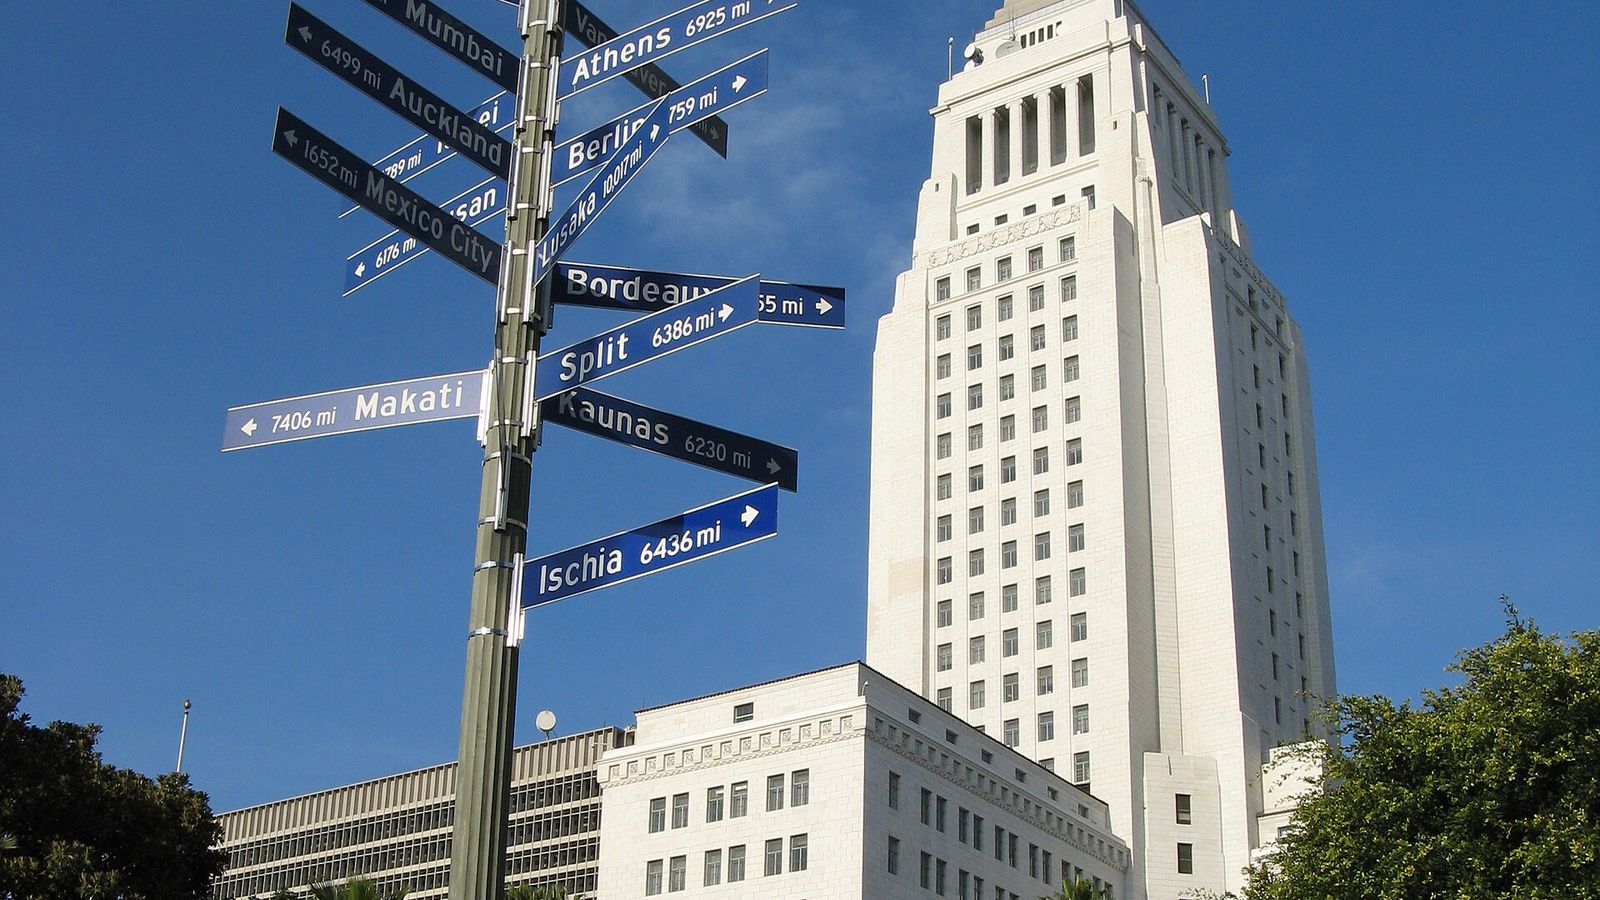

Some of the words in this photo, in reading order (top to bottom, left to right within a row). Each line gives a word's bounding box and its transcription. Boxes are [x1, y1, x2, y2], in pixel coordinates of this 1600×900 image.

[405, 0, 504, 76] Mumbai
[572, 27, 671, 85] Athens
[685, 7, 726, 37] 6925
[731, 0, 750, 20] mi
[321, 40, 361, 74] 6499
[364, 67, 381, 90] mi
[389, 78, 502, 167] Auckland
[669, 97, 696, 124] 759
[699, 86, 717, 110] mi
[407, 149, 422, 170] mi
[304, 139, 337, 176] 1652
[340, 167, 358, 189] mi
[366, 171, 443, 240] Mexico
[451, 224, 493, 273] City
[375, 243, 400, 268] 6176
[449, 188, 497, 222] san
[542, 192, 596, 268] Lusaka
[603, 154, 630, 198] 10,017
[630, 141, 643, 169] mi
[567, 269, 718, 305] Bordeau
[782, 298, 804, 315] mi
[559, 332, 629, 382] Split
[652, 320, 694, 348] 6386
[696, 307, 715, 332] mi
[271, 411, 312, 433] 7406
[316, 406, 337, 426] mi
[354, 380, 463, 421] Makati
[559, 391, 670, 445] Kaunas
[685, 435, 726, 462] 6230
[733, 451, 751, 468] mi
[539, 547, 622, 594] Ischia
[640, 533, 693, 565] 6436
[697, 520, 721, 546] mi
